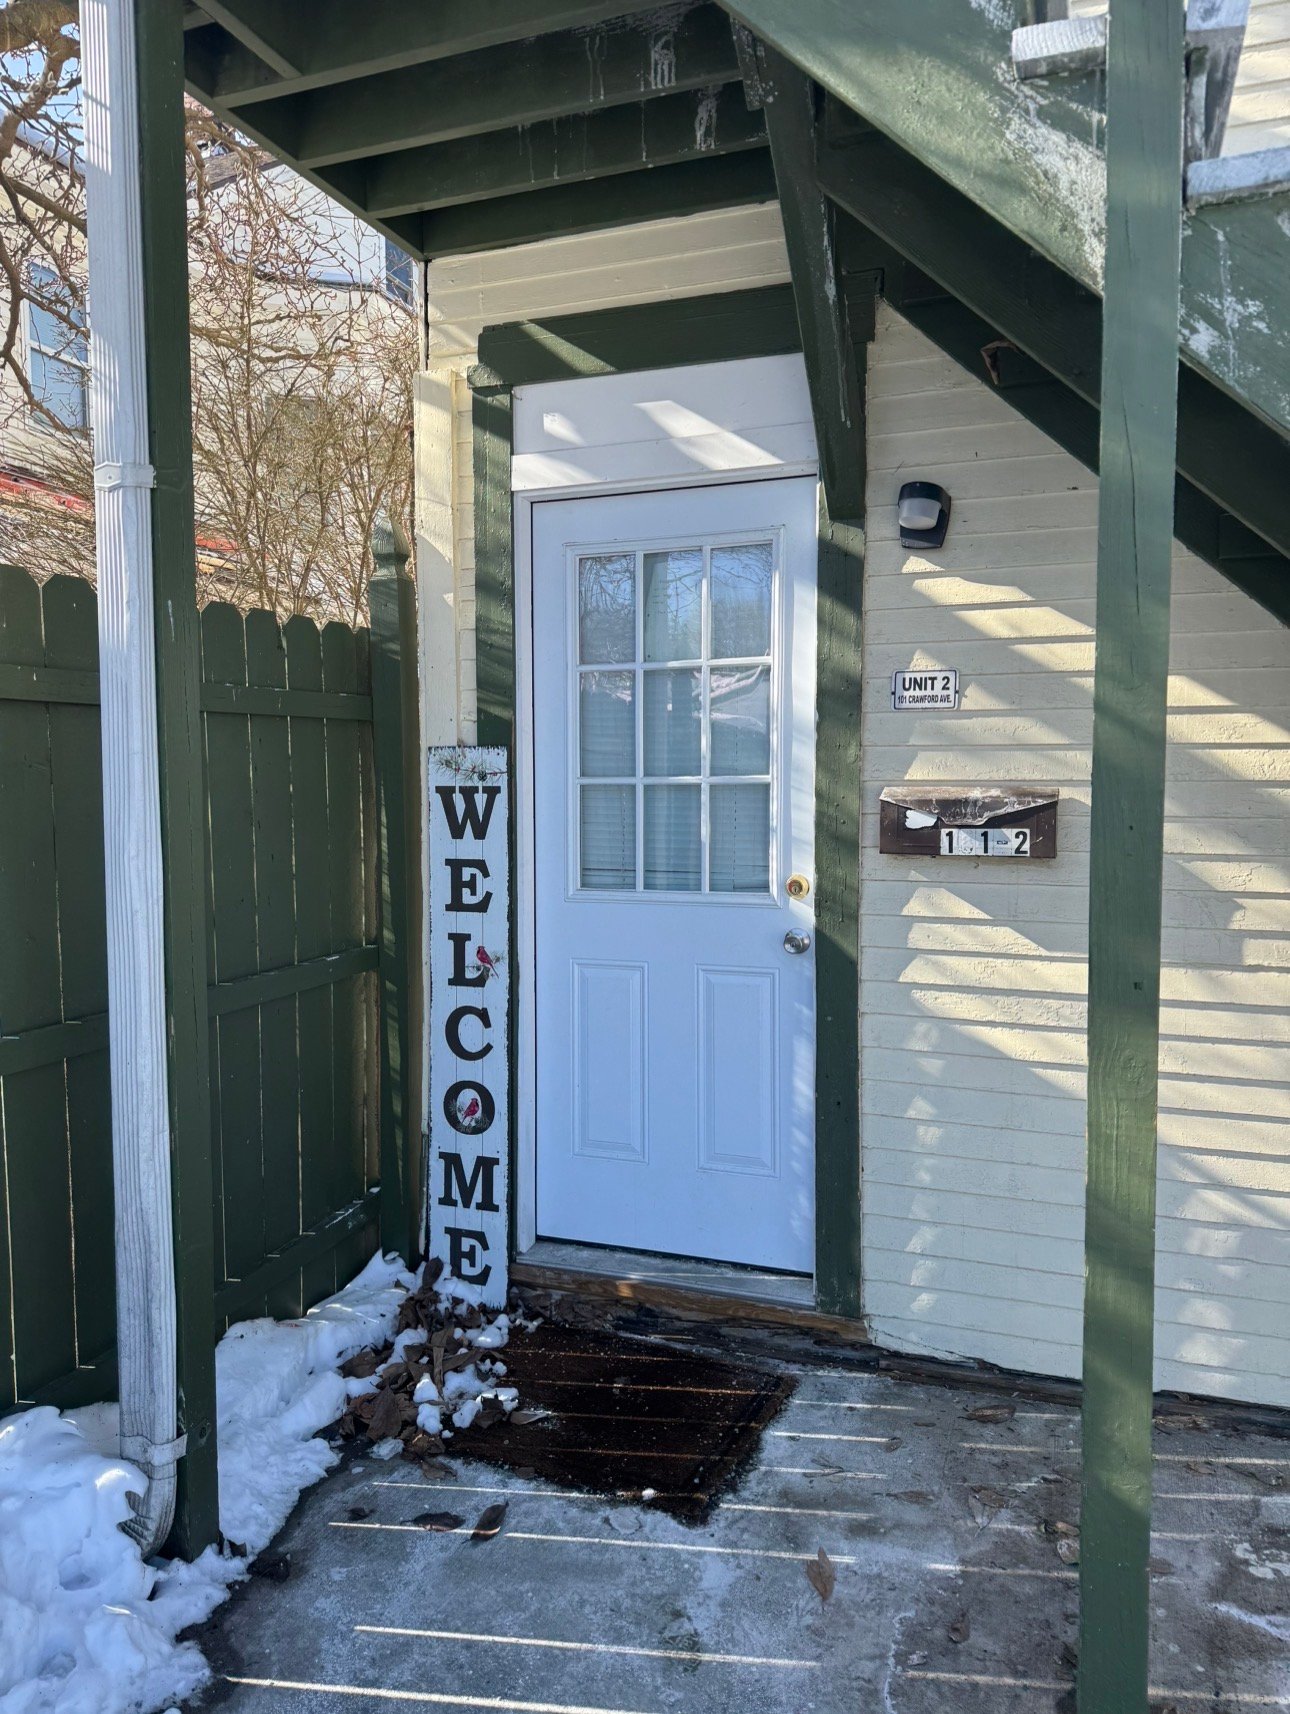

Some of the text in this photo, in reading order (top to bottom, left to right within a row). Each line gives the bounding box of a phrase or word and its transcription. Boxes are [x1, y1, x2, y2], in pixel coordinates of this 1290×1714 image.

[902, 675, 950, 691] UNIT 2
[898, 694, 952, 704] 101 CRAWFORD AVE.
[435, 786, 502, 1286] WELCOME
